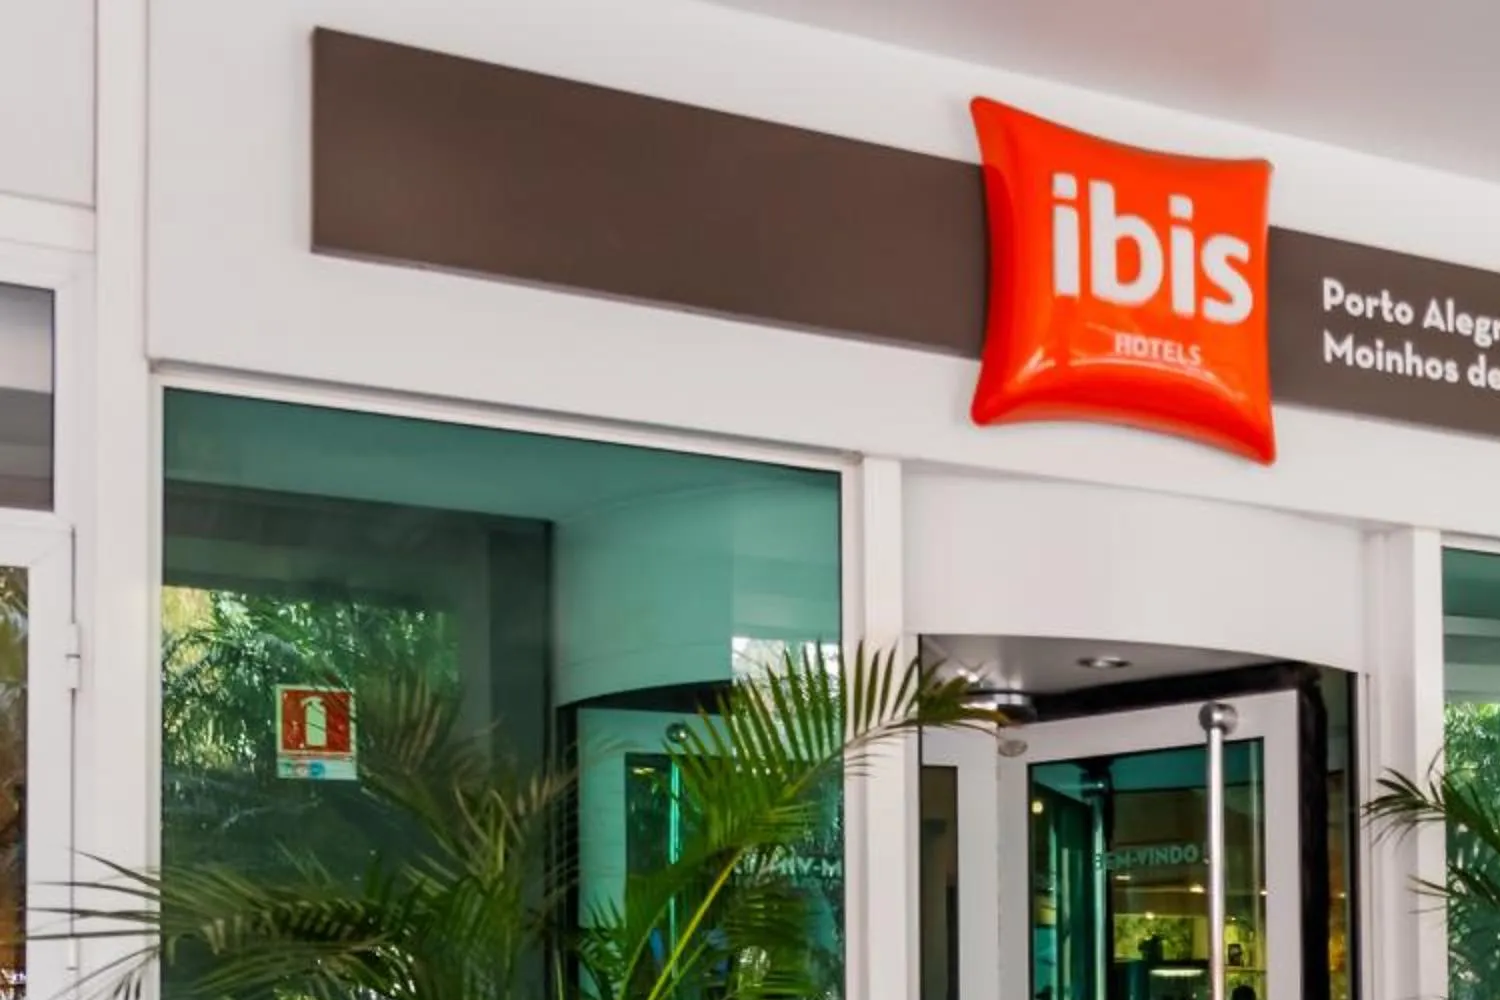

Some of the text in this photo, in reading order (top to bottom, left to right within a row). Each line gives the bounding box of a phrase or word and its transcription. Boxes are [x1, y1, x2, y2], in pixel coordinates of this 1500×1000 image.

[1052, 172, 1253, 325] ibis
[1323, 277, 1414, 325] Porto
[1115, 332, 1202, 366] HOTELS
[1323, 329, 1459, 383] Moinhos
